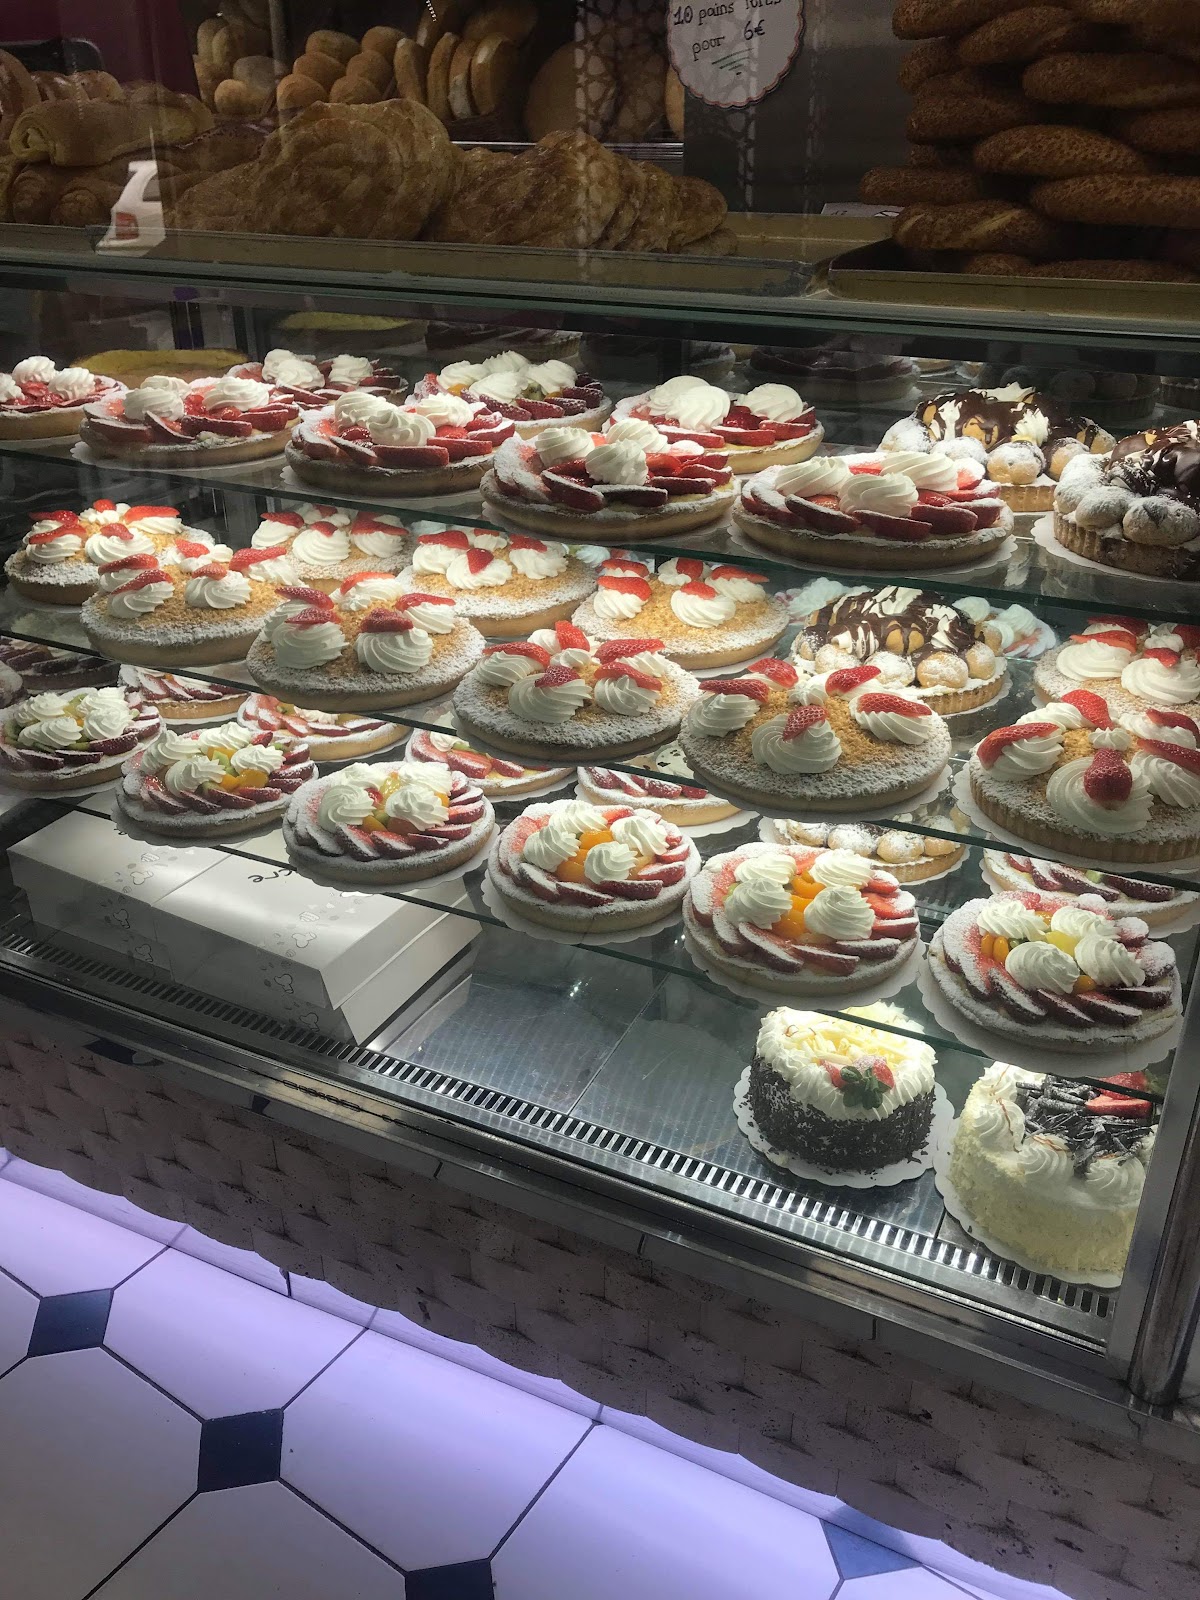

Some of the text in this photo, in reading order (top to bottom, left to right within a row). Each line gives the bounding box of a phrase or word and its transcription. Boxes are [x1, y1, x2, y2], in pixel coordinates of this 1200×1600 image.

[673, 5, 693, 26] 10
[698, 2, 735, 26] pains
[692, 19, 765, 61] pour 6€
